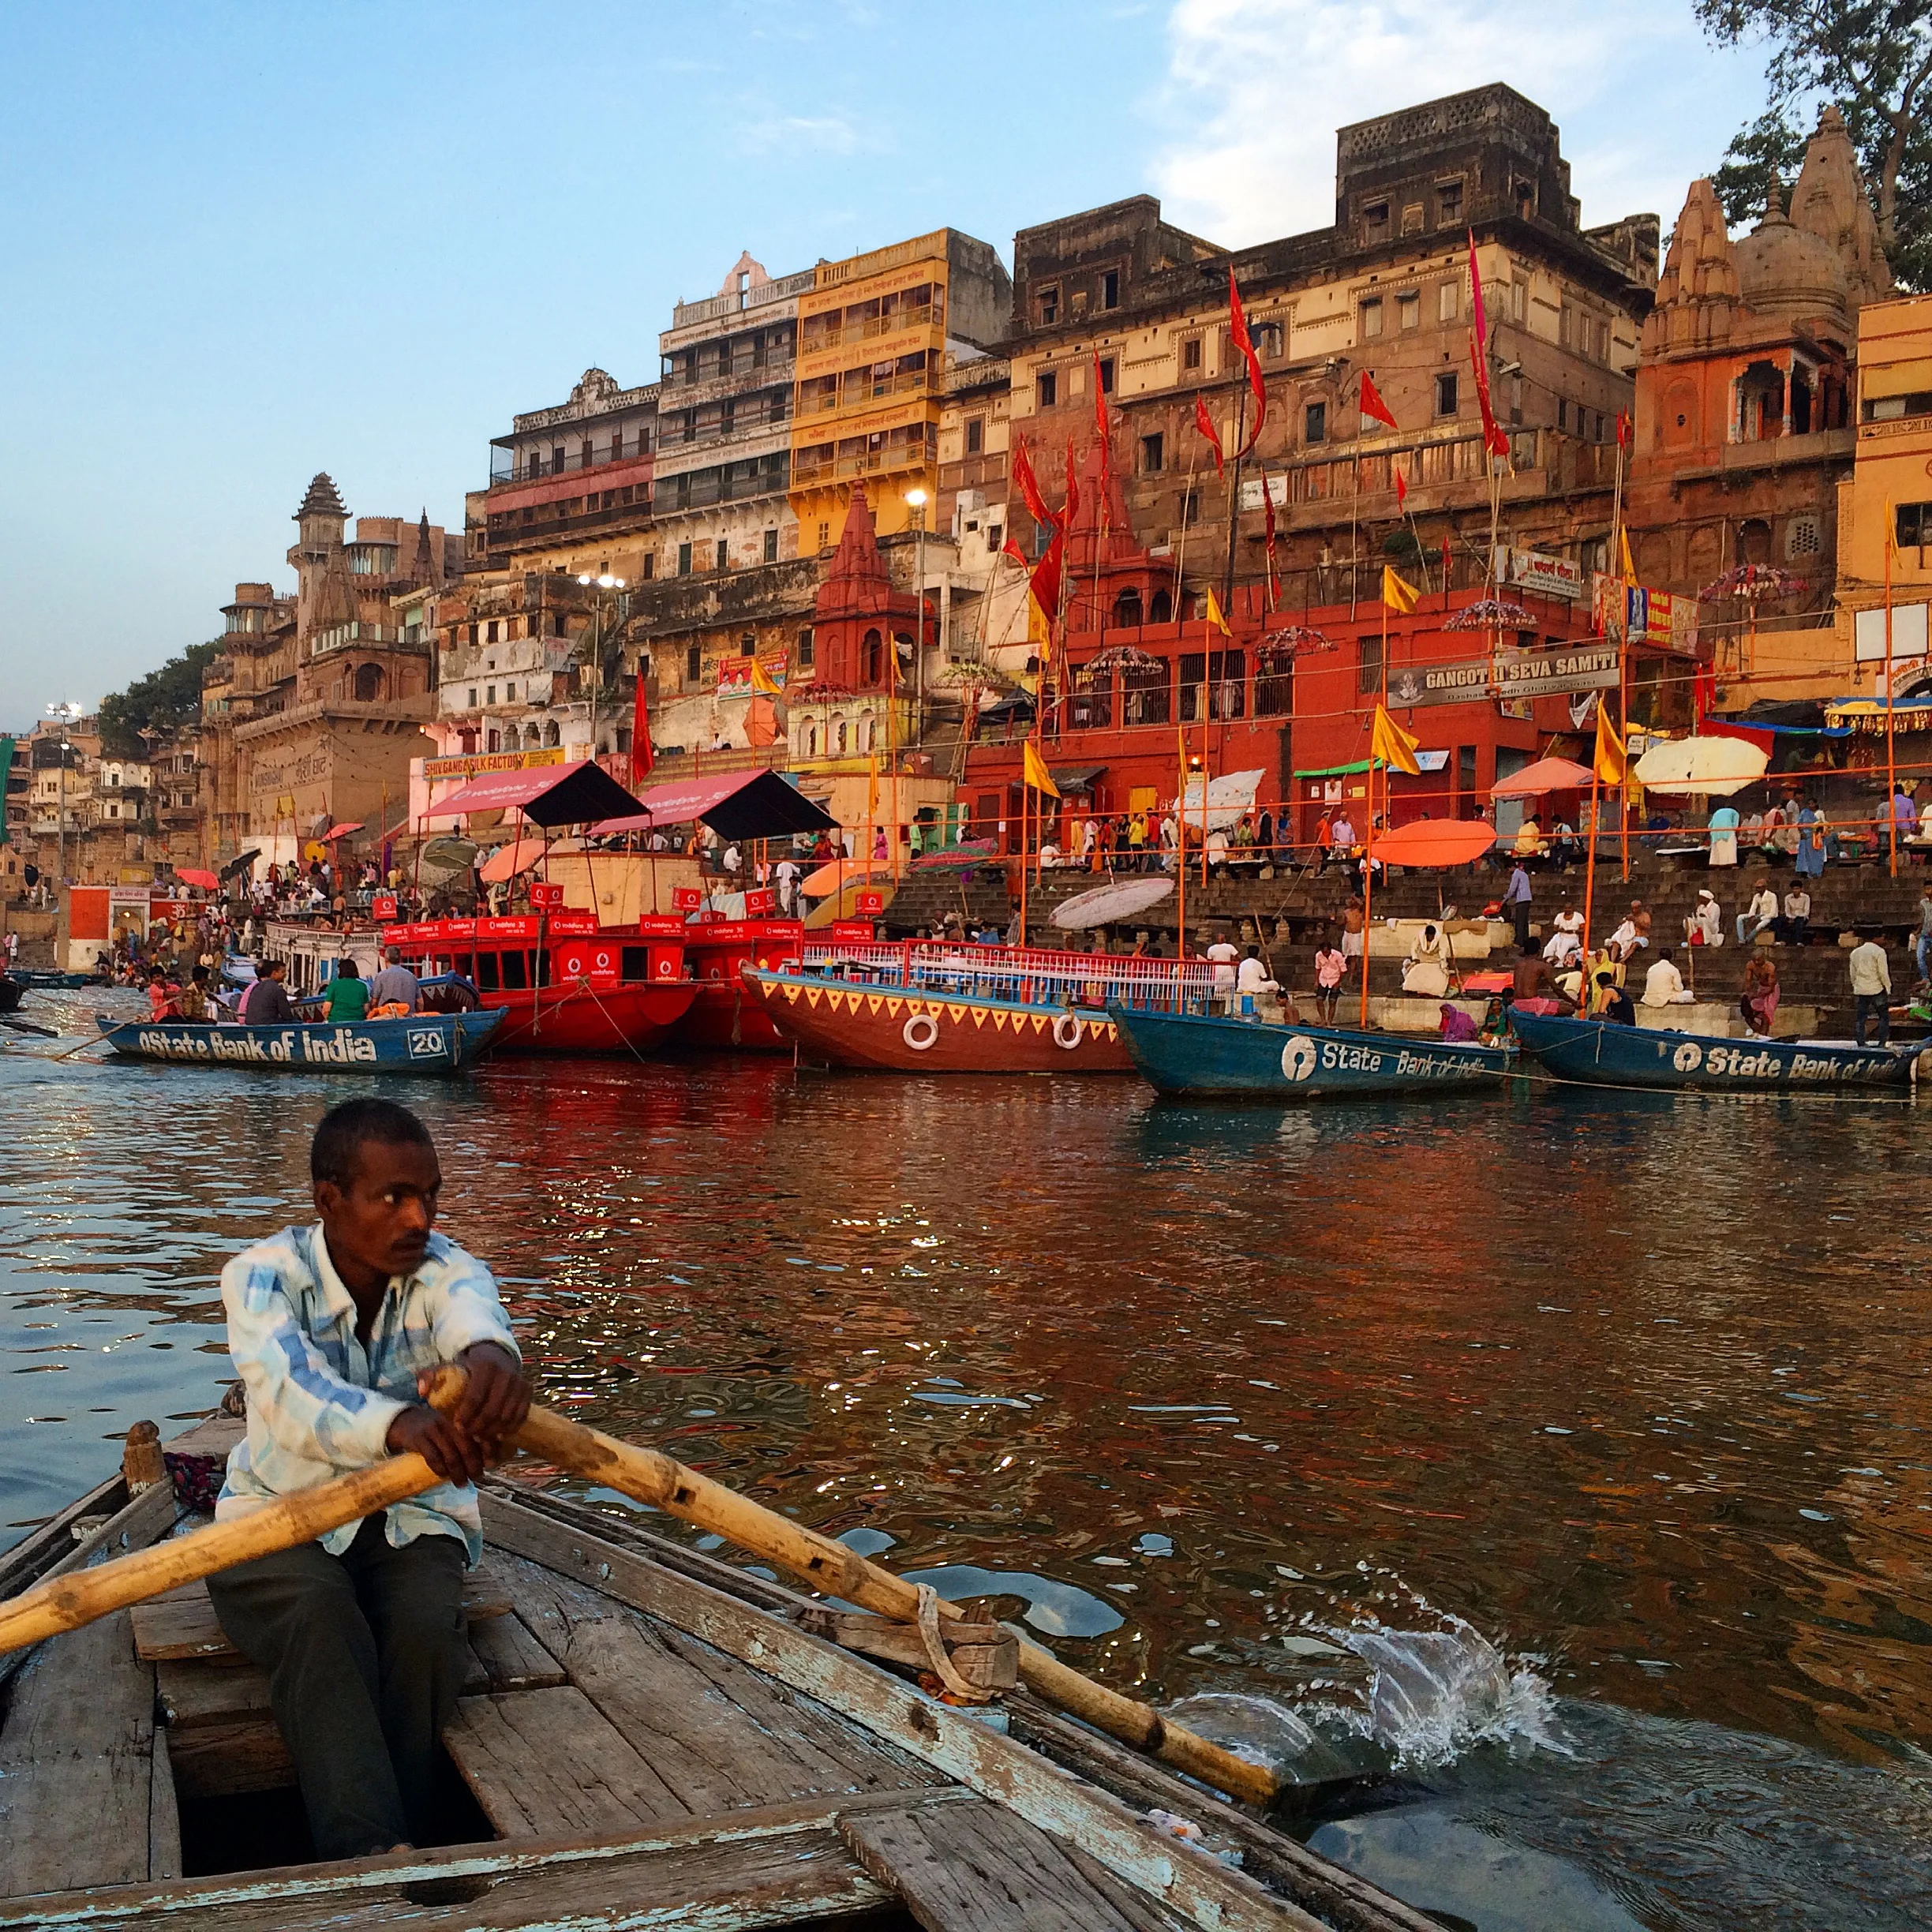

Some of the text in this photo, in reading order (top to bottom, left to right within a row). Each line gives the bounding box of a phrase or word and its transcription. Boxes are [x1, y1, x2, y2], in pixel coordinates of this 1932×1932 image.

[1426, 652, 1616, 689] GANGOTRI SEVA SAMITI
[469, 756, 487, 772] SILK
[209, 1032, 269, 1061] Bank
[302, 1028, 376, 1063] India
[412, 1032, 443, 1054] 20
[1322, 1042, 1381, 1073] State
[1395, 1050, 1437, 1078] Bank
[1705, 1046, 1781, 1078] State
[1788, 1054, 1841, 1080] Bank
